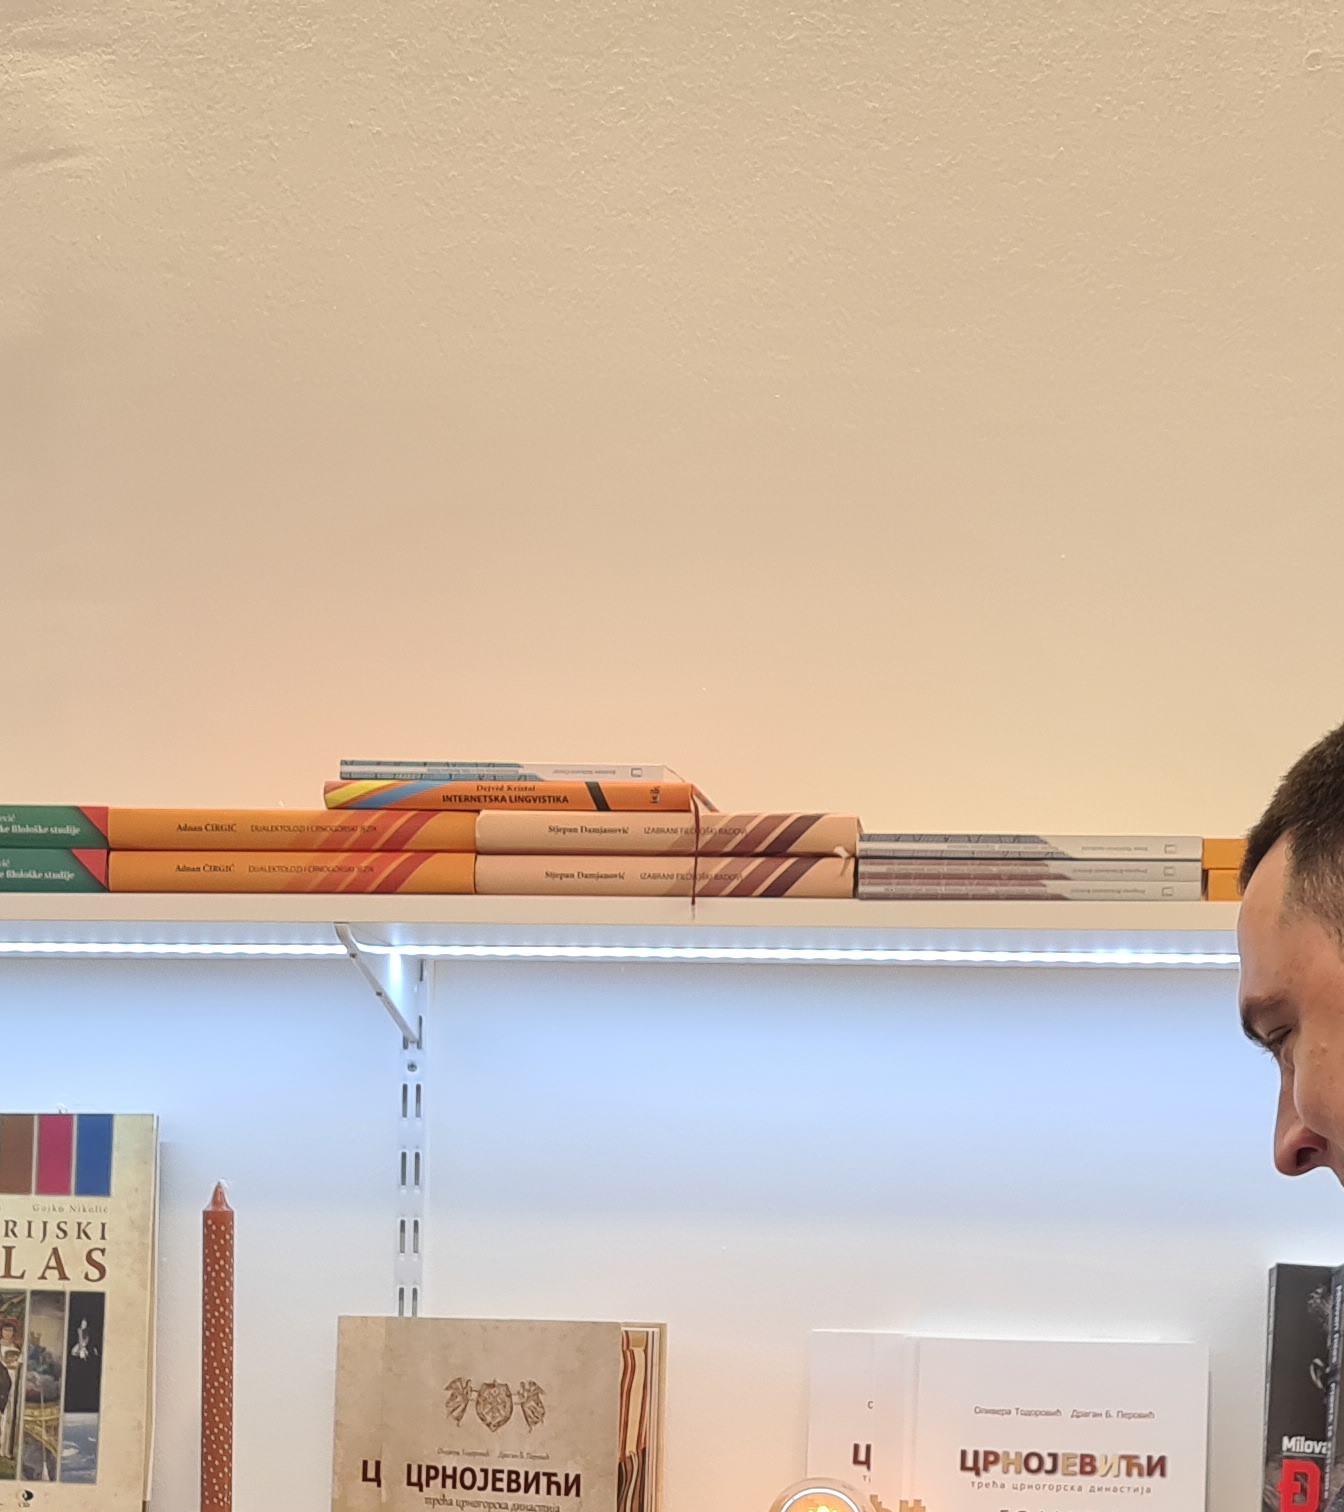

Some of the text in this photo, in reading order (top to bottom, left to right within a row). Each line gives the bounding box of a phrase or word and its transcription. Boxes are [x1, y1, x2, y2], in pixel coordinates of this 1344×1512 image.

[442, 794, 569, 804] INTERNETSKA LINGVISTIKA
[50, 824, 81, 836] studije
[44, 870, 75, 881] studije
[1282, 1435, 1331, 1456] Milova
[959, 1448, 1168, 1479] ЦРНОЈЕВИЋИ
[406, 1463, 582, 1498] ЦРНОЈЕВИЋИ
[971, 1480, 1152, 1496] трећа црногорска династија
